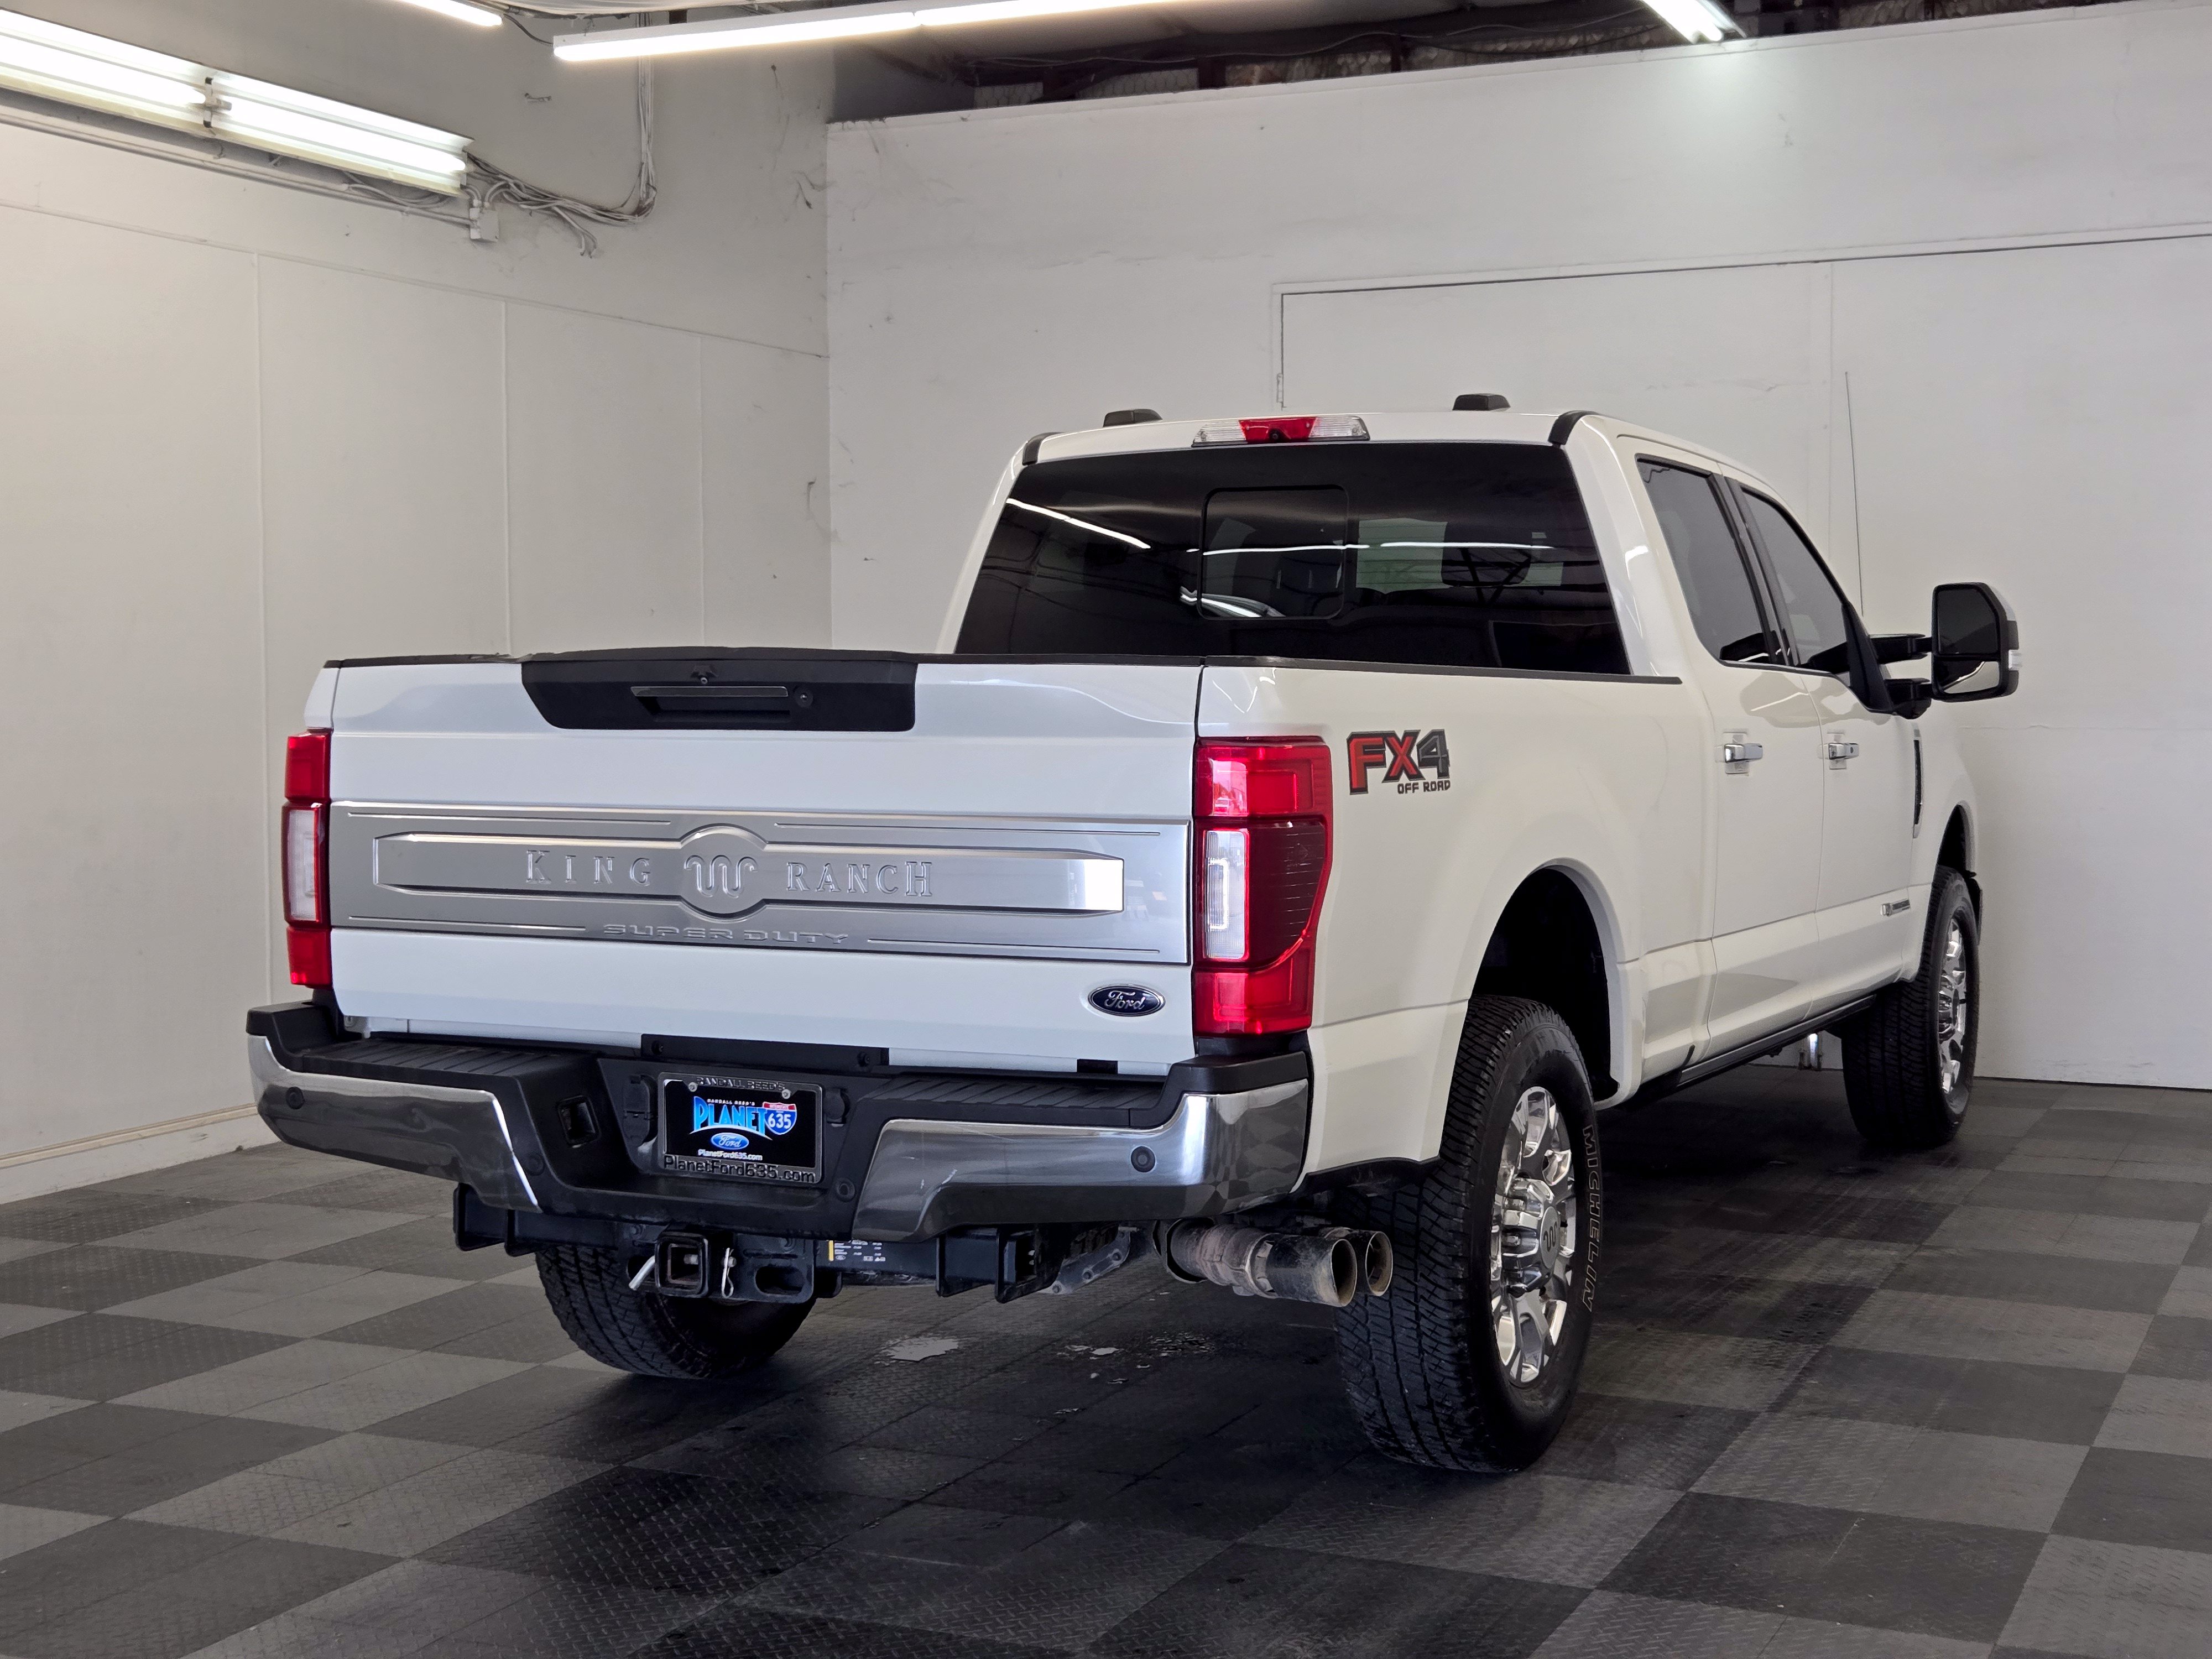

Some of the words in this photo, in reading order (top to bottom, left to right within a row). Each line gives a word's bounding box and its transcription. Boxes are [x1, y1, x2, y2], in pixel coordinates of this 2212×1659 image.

[1346, 729, 1451, 795] FX4
[1397, 782, 1419, 794] OFF
[1423, 780, 1451, 792] ROAD
[526, 849, 651, 886] KING
[786, 861, 933, 897] RANCH
[603, 924, 733, 940] SUPER
[744, 930, 849, 945] DUTY
[1104, 990, 1146, 1010] Ford
[697, 1077, 745, 1088] RANDALL
[747, 1081, 785, 1091] REED'S
[693, 1096, 768, 1136] PLANET
[768, 1113, 791, 1129] 635
[718, 1134, 741, 1149] Ford
[698, 1149, 763, 1161] PlanetFord635.com
[664, 1154, 816, 1183] PlanetFord635.com
[1582, 1125, 1600, 1312] MICHELIN
